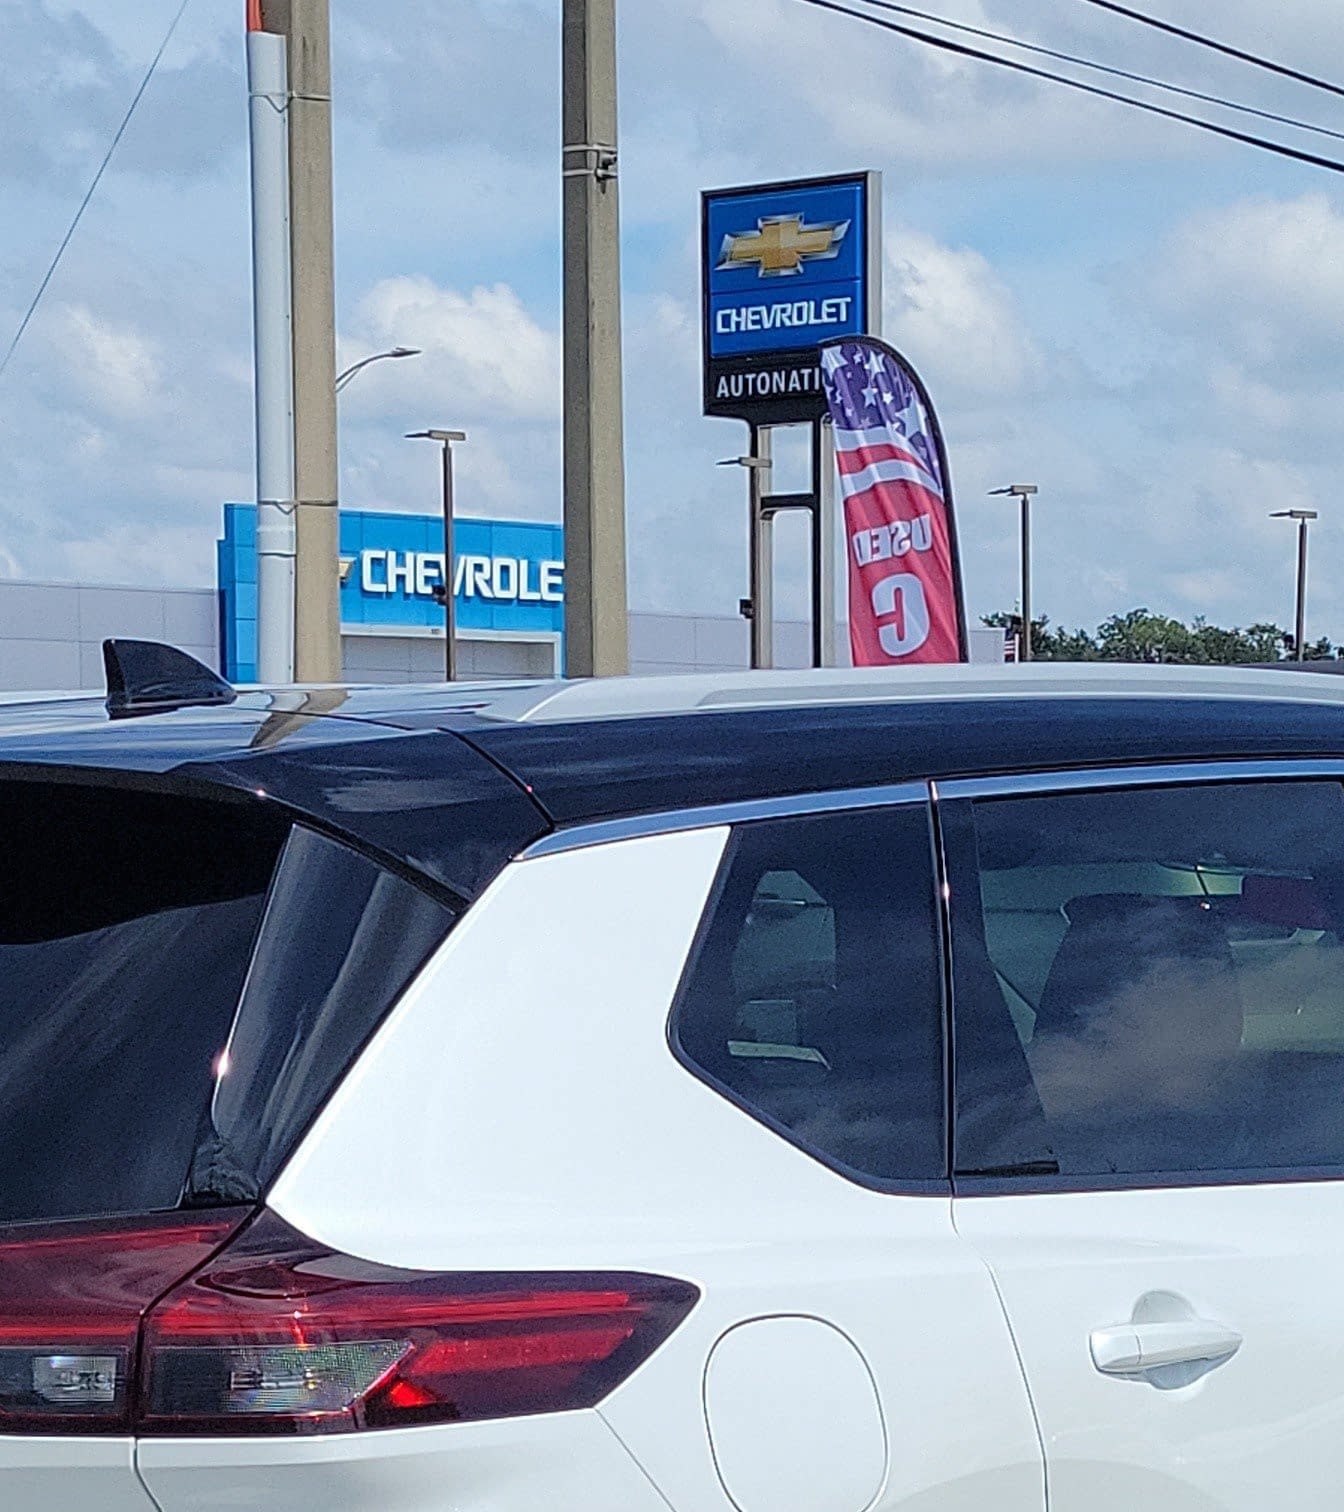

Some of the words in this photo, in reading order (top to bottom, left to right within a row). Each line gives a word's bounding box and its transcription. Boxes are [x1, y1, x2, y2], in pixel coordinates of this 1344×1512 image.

[716, 297, 852, 334] CHEVROLET
[716, 367, 825, 399] AUTONATI
[362, 549, 565, 602] CHEVROLE
